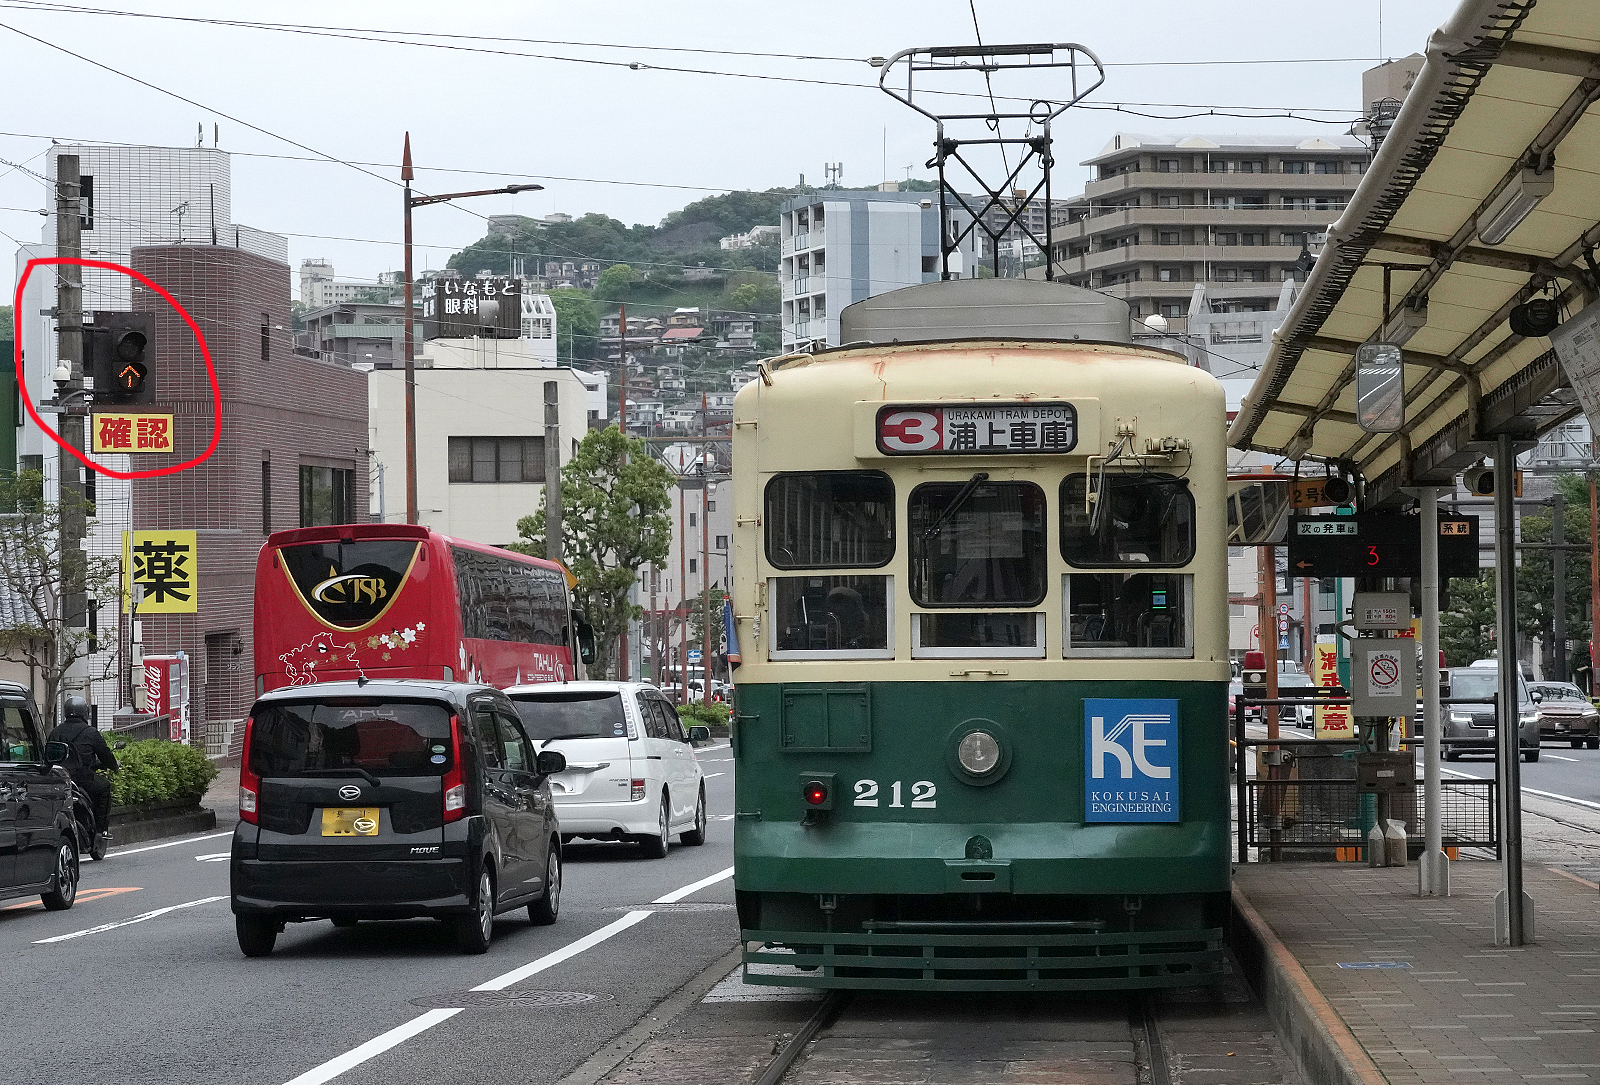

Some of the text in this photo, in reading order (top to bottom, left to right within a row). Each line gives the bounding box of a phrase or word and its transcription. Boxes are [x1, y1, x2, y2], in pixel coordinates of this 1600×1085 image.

[445, 280, 515, 296] いなもと
[445, 296, 478, 315] 眼科
[948, 409, 1068, 421] URAKAMI TRAM DEPOT
[99, 417, 170, 449] 確認
[883, 411, 940, 451] 3
[948, 420, 1068, 450] 浦上車庫
[1293, 487, 1328, 504] 2号
[1301, 523, 1356, 534] 次の発車は
[1443, 523, 1467, 534] 系統
[1367, 545, 1380, 566] 3
[134, 541, 192, 603] 薬
[1091, 714, 1171, 779] KE
[853, 779, 938, 809] 212
[1091, 791, 1170, 801] KOKUSAI
[1091, 803, 1172, 813] ENGINEERING
[410, 846, 440, 854] MOVE
